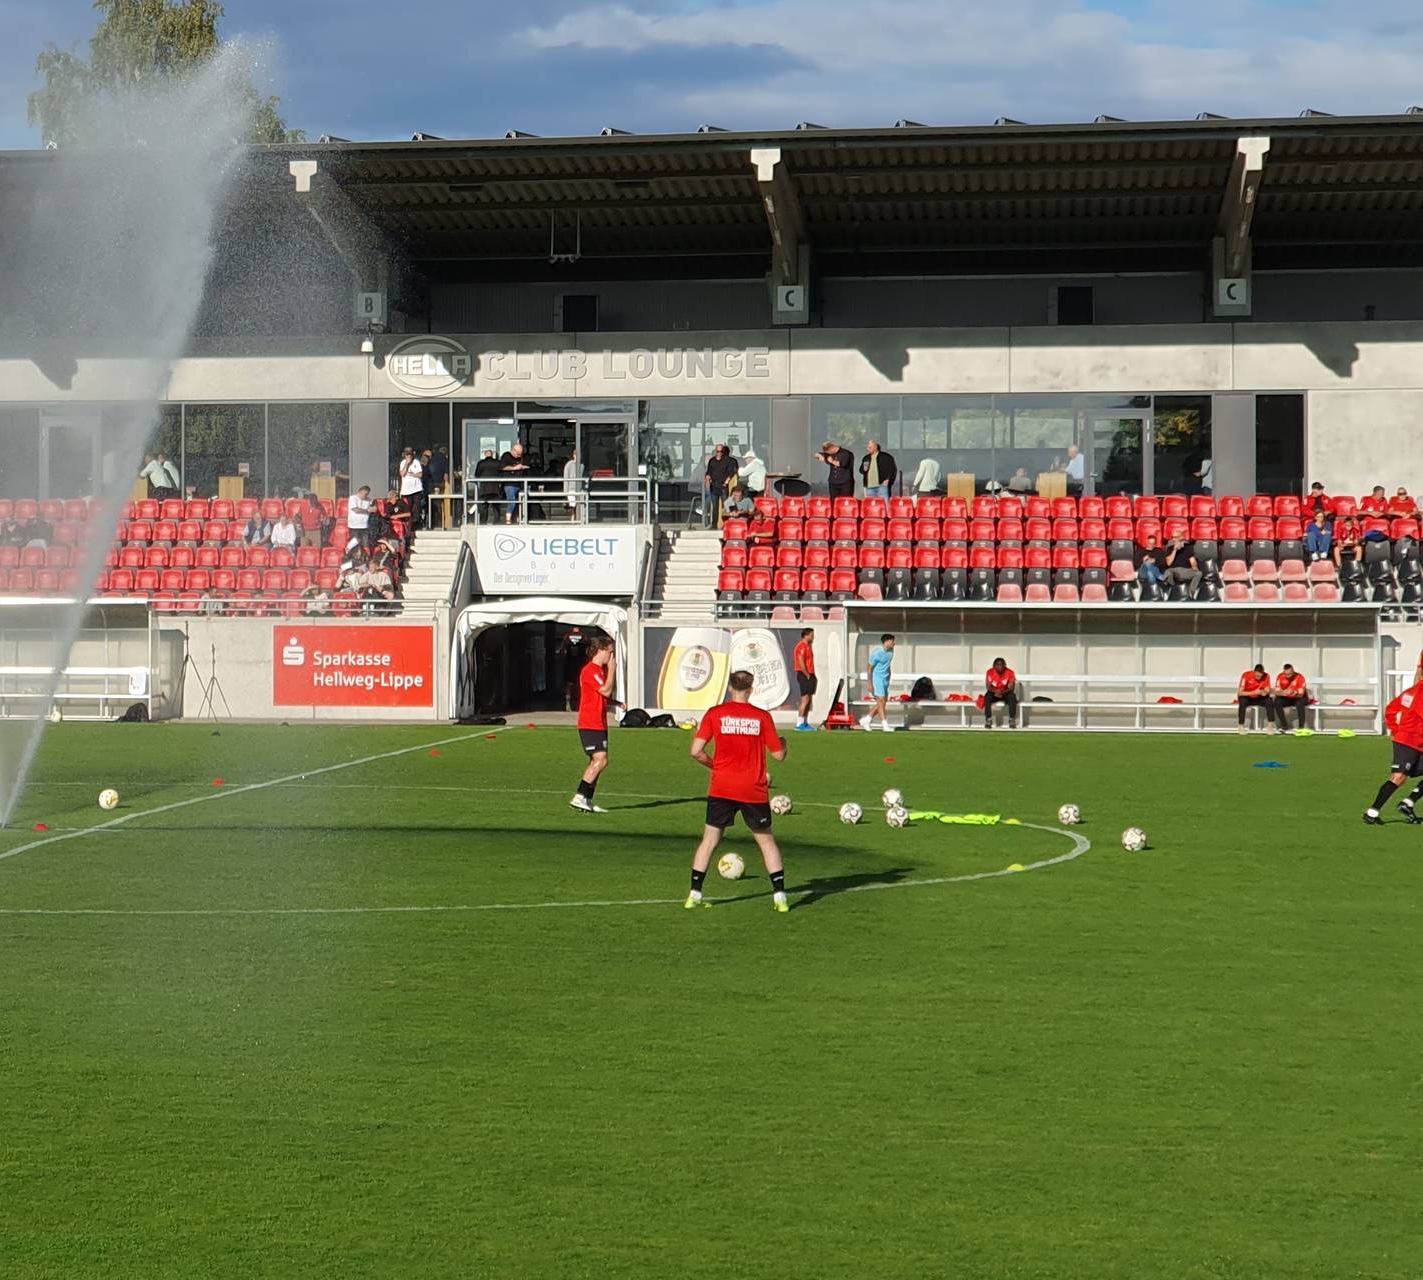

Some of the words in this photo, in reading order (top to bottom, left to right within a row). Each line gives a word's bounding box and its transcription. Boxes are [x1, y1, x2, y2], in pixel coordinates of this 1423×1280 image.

[785, 290, 795, 307] C
[1227, 283, 1237, 300] C
[364, 297, 373, 313] B
[393, 354, 471, 376] HELLA
[482, 348, 587, 381] CLUB
[602, 346, 770, 380] LOUNGE
[530, 538, 619, 556] LIEBELT
[312, 651, 391, 669] Sparkasse
[313, 671, 424, 690] Hellweg-Lippe
[720, 715, 761, 728] TÜRKSPOR
[720, 726, 761, 736] DORTMUND
